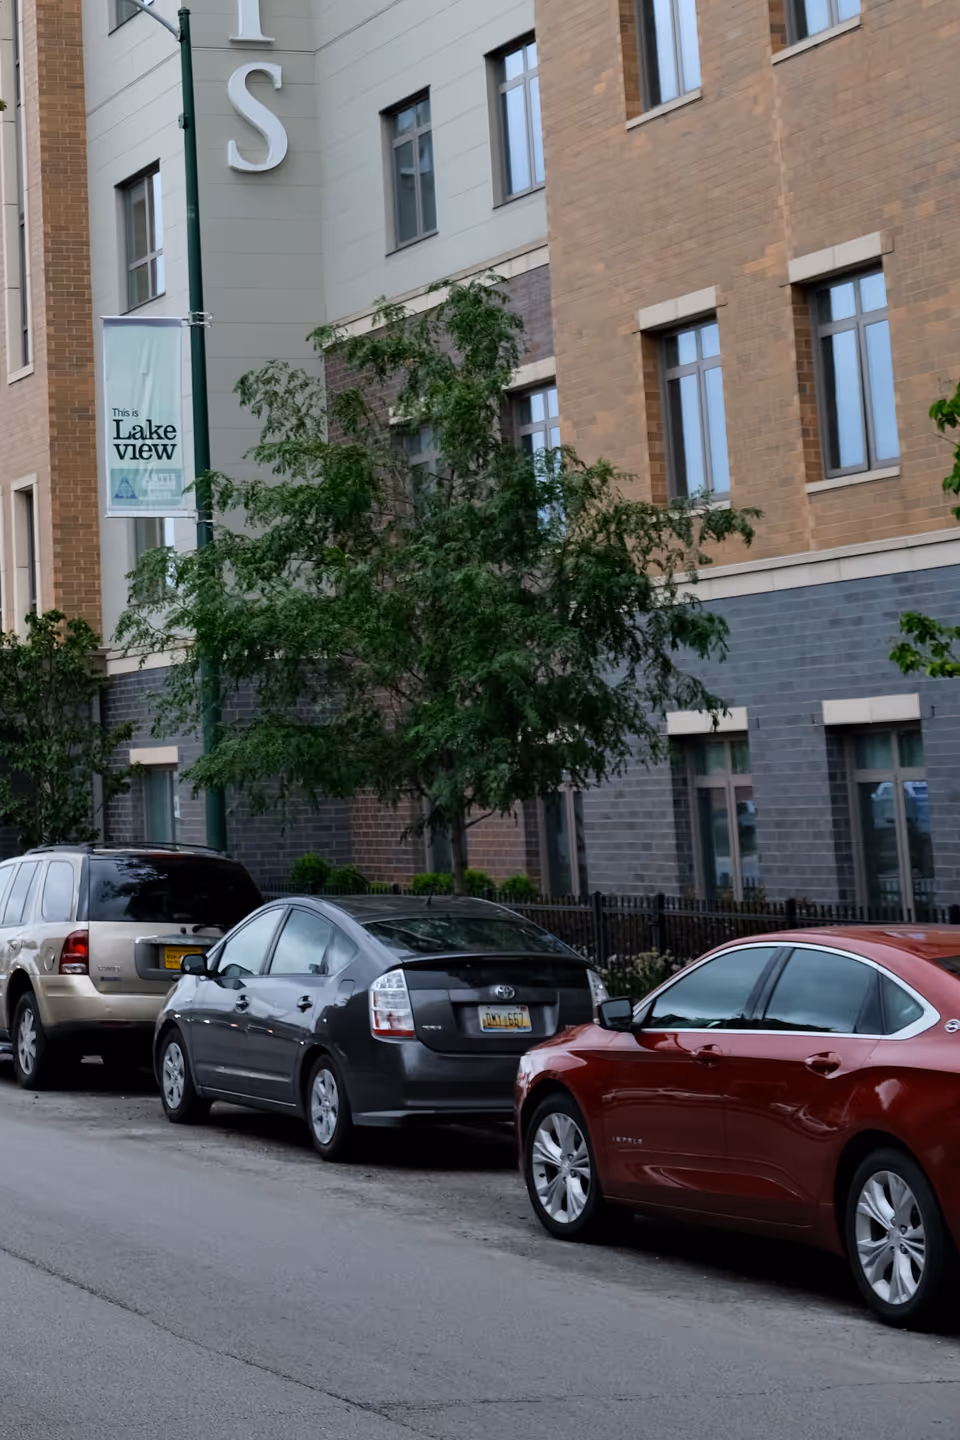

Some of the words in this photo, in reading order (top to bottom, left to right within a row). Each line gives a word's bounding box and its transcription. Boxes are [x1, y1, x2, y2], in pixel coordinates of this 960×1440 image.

[112, 407, 130, 417] This
[131, 407, 139, 417] is
[112, 418, 177, 441] Lake
[112, 443, 177, 460] view
